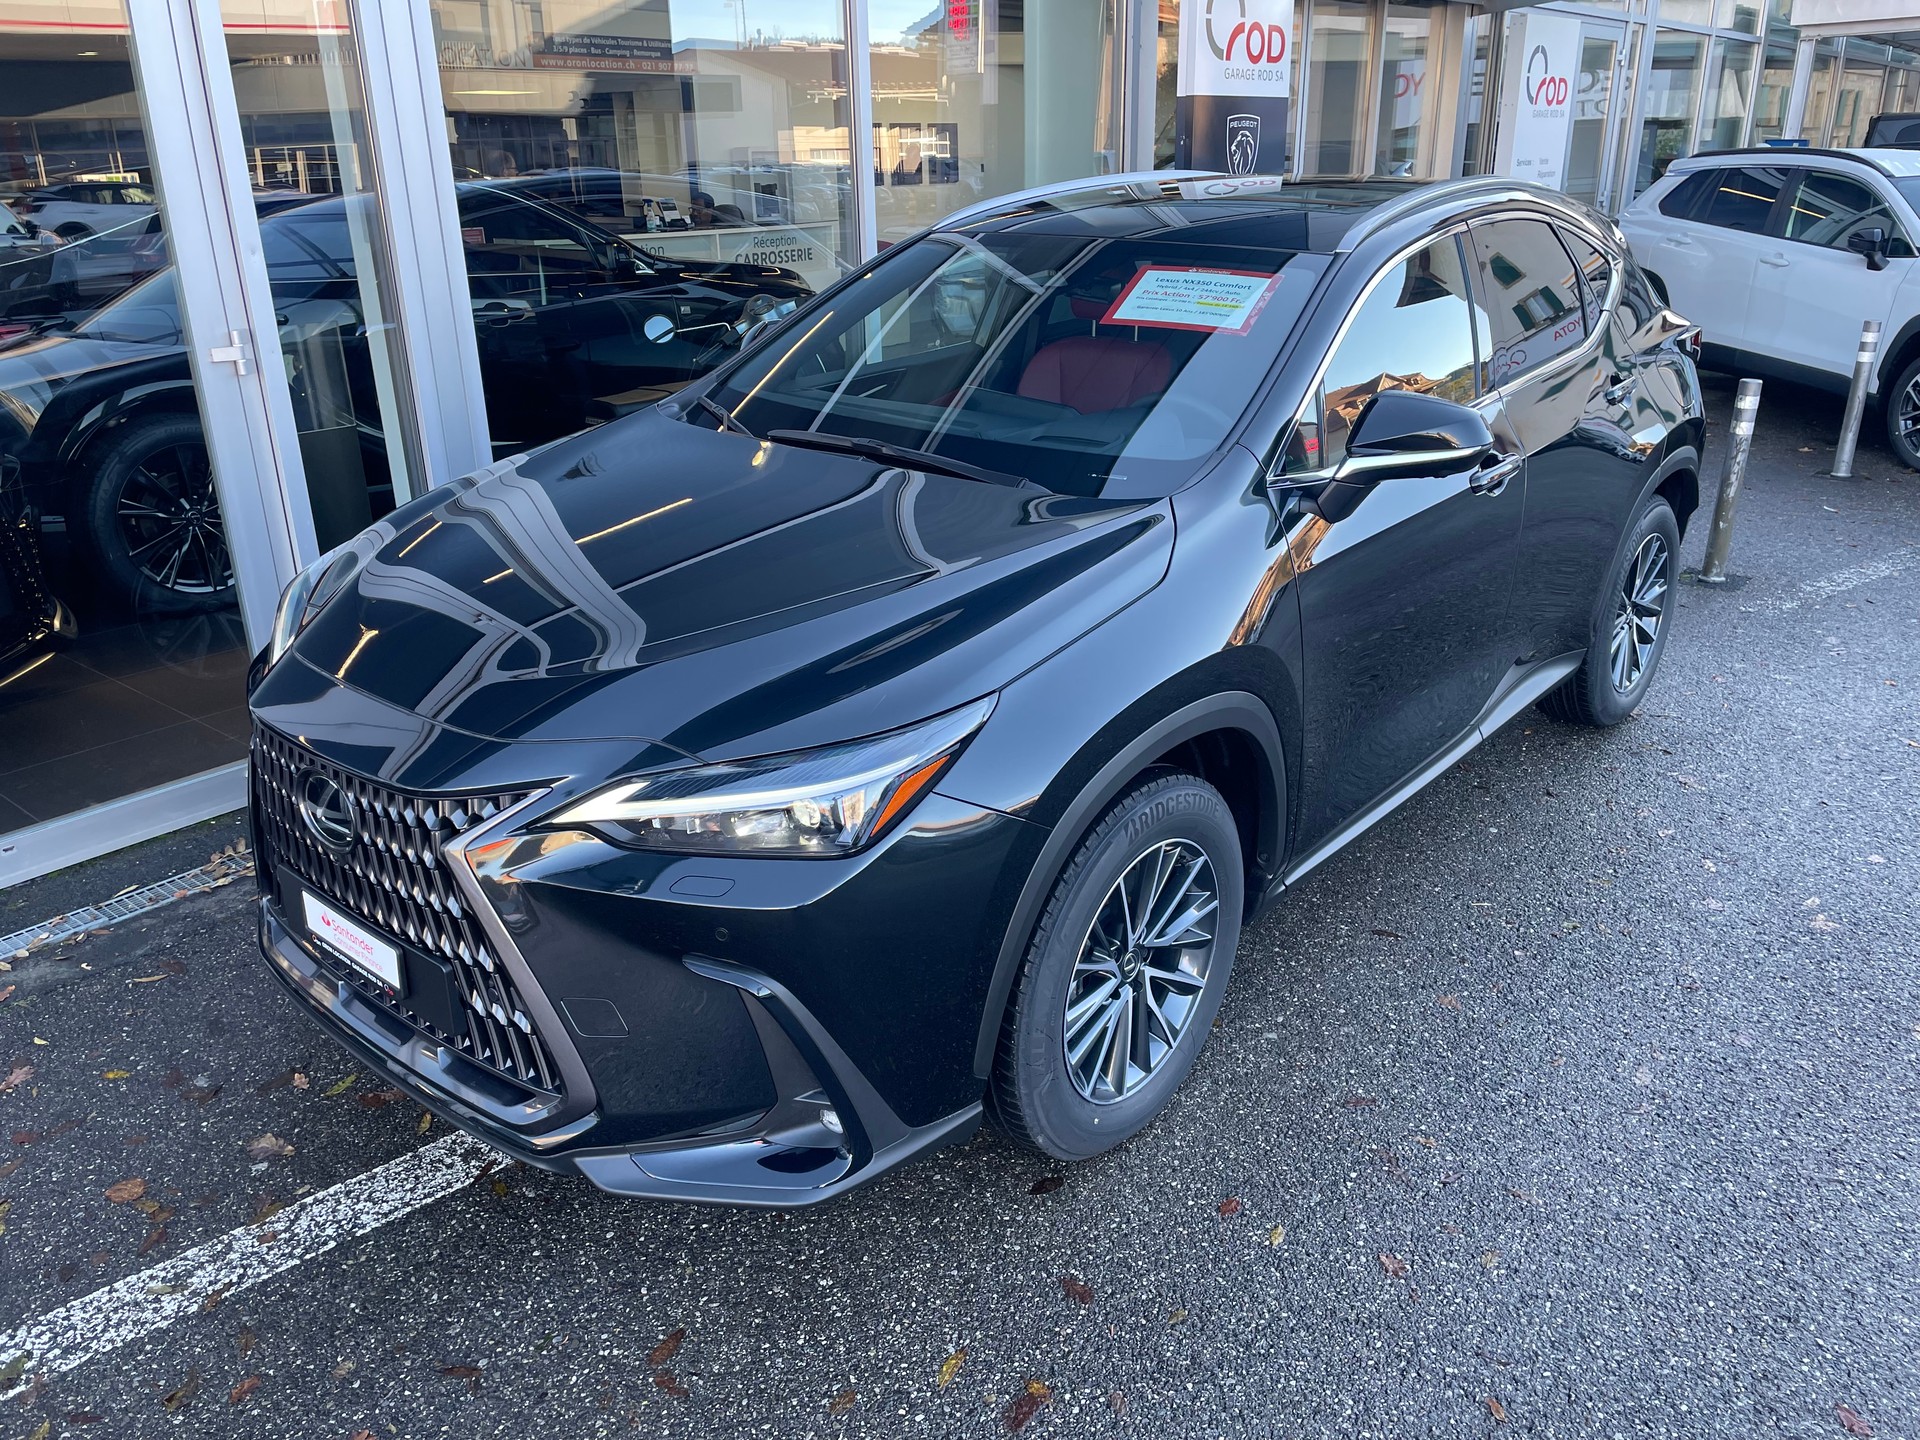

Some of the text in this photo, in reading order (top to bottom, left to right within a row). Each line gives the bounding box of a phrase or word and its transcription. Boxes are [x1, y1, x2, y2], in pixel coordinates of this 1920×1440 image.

[591, 37, 617, 46] Véhicules
[569, 46, 587, 54] places
[591, 47, 602, 55] Bus
[605, 48, 630, 57] Camping
[540, 58, 635, 69] www.oronlocation.ch
[642, 62, 656, 70] 021
[659, 63, 671, 71] 907
[1224, 67, 1284, 82] GARAGE ROD SA
[1532, 109, 1549, 119] GARAGE
[1550, 109, 1559, 119] ROD
[1230, 120, 1258, 128] PEUGEOT
[1516, 157, 1532, 167] Services
[753, 235, 797, 250] Réception
[735, 247, 813, 265] CARROSSERIE
[1213, 281, 1252, 290] Comfort
[1198, 294, 1229, 302] 57'900
[1123, 792, 1220, 847] BRIDGESTONE
[331, 919, 374, 956] Santander
